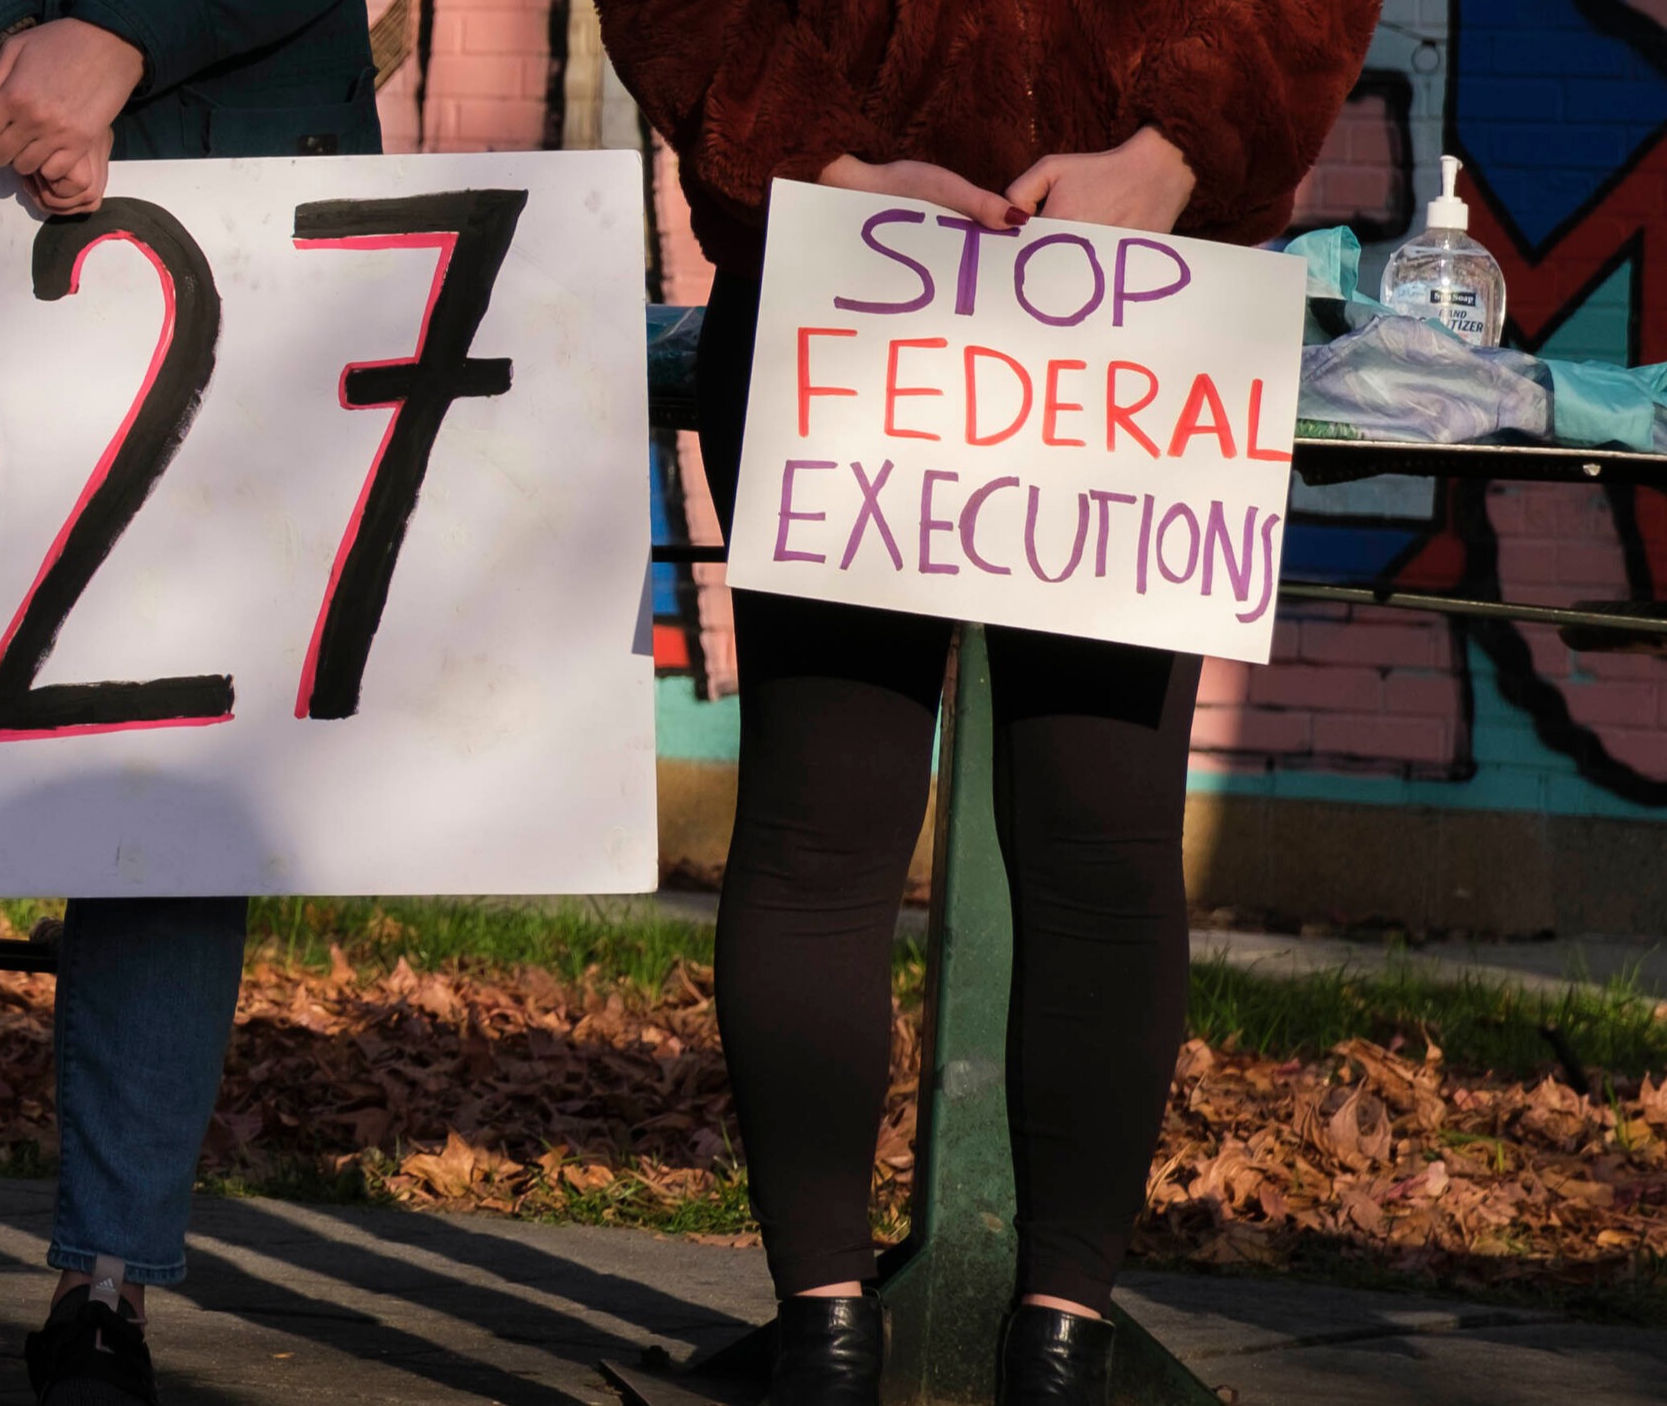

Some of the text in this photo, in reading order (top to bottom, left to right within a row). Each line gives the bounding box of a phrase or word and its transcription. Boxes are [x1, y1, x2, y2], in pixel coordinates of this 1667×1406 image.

[833, 207, 1192, 328] STOP
[796, 326, 1293, 462] FEDERAL
[773, 459, 1281, 624] EXECUTIONS
